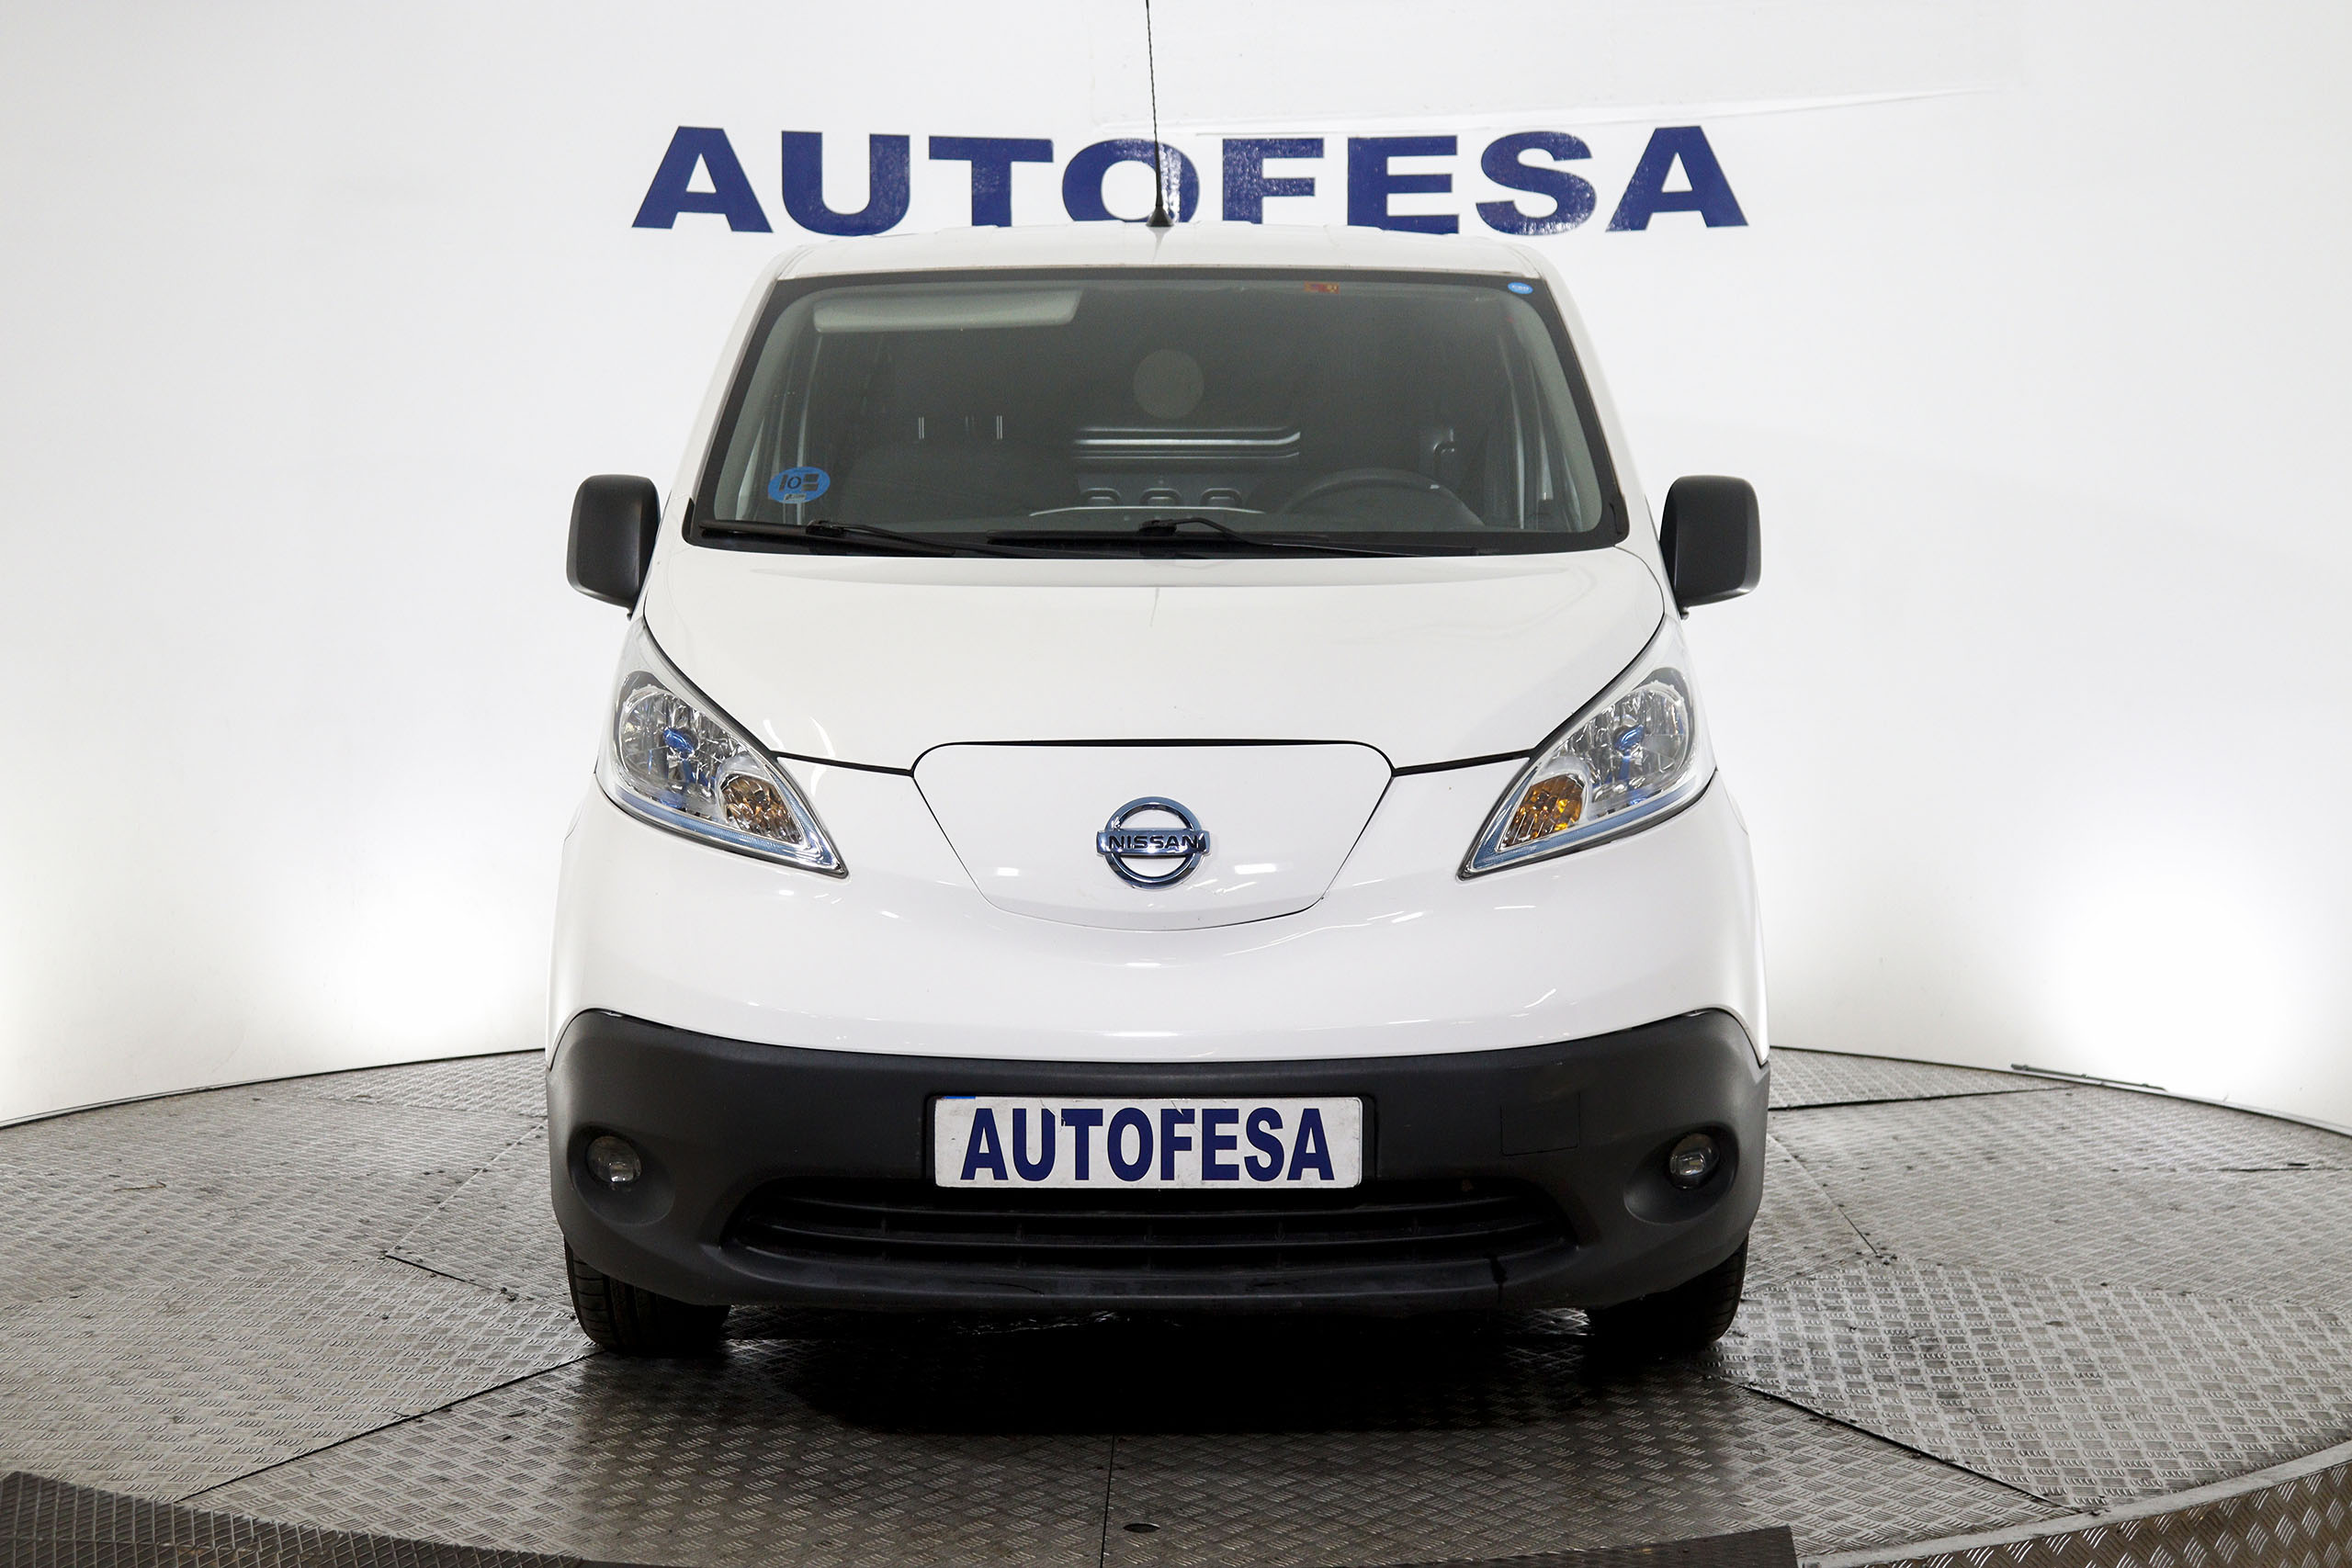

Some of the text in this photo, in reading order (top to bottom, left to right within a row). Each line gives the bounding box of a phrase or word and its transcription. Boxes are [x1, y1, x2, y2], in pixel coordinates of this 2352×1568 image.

[631, 126, 1747, 236] AUTOFESA
[1108, 835, 1198, 850] NISSAN
[961, 1107, 1335, 1181] AUTOFESA
